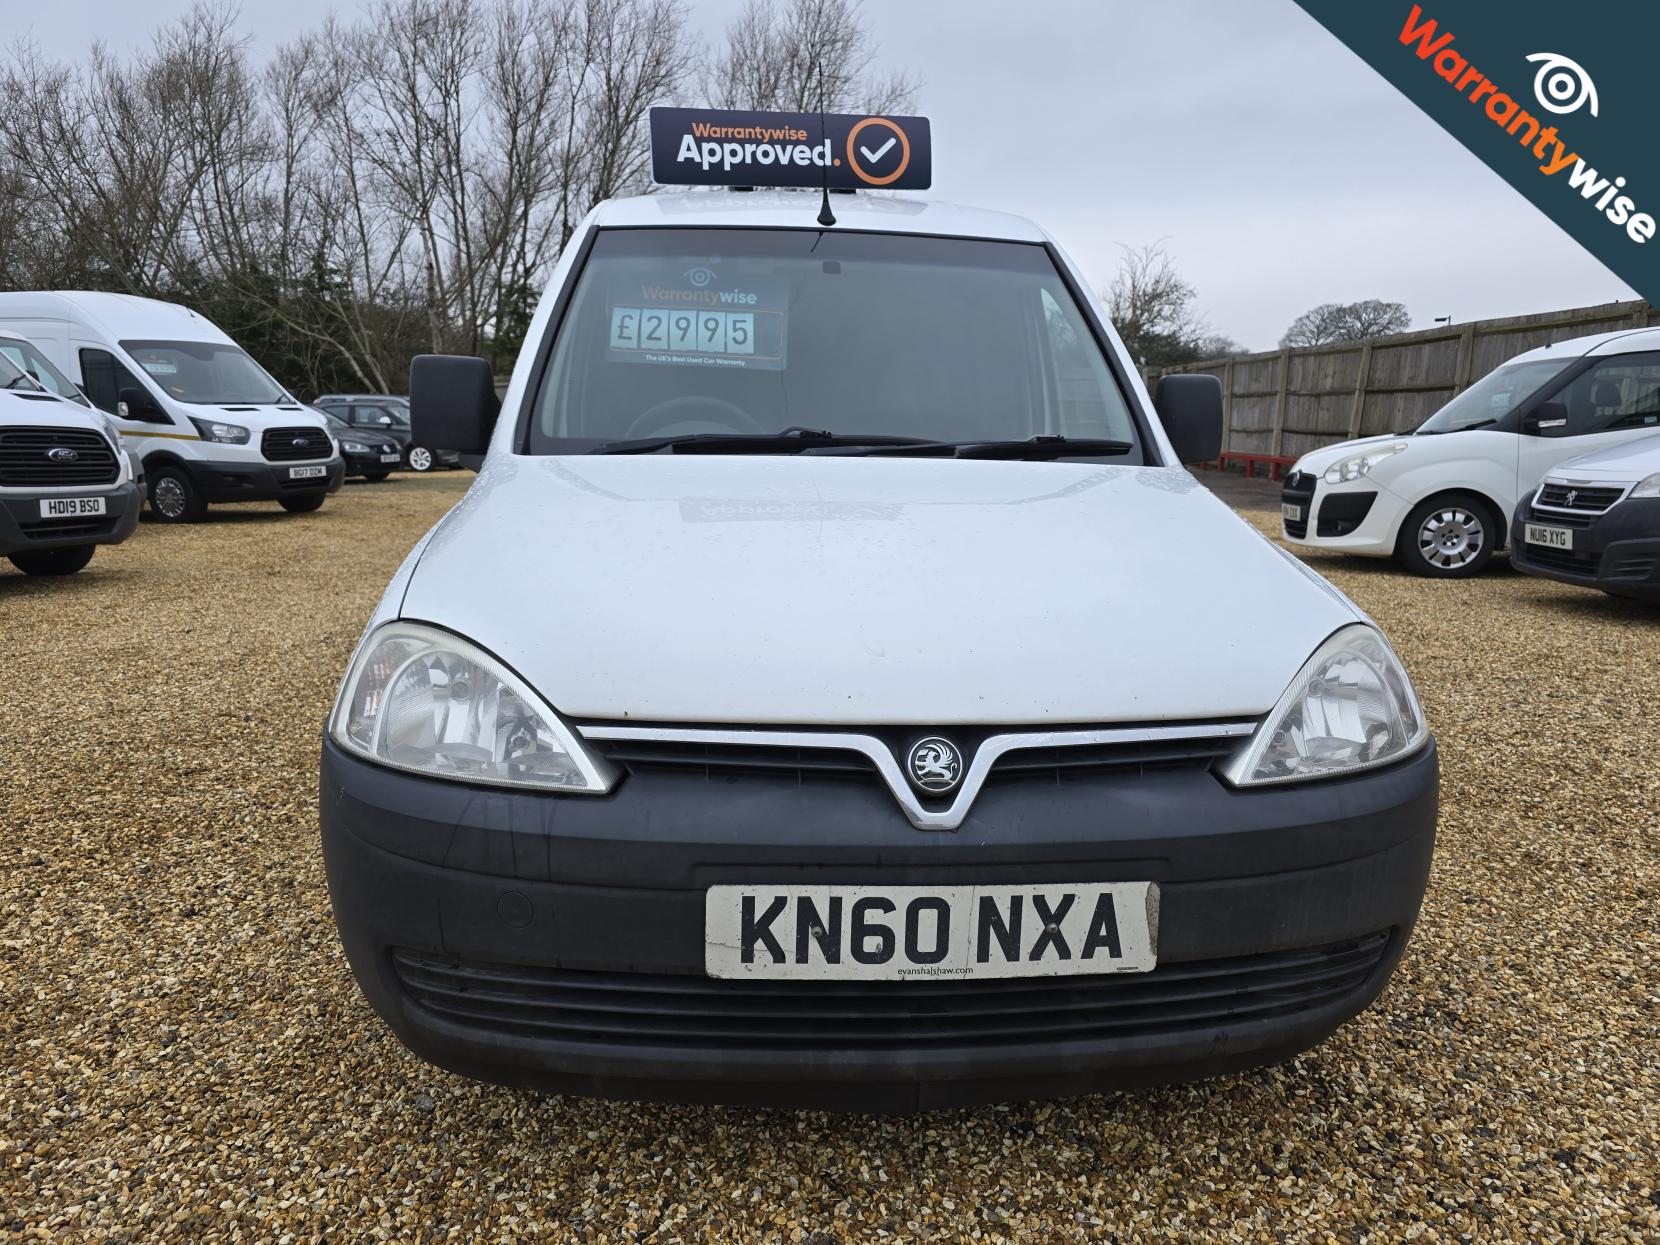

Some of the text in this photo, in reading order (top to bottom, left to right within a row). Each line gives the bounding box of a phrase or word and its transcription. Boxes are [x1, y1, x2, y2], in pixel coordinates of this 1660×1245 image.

[691, 122, 808, 143] Warrantywise
[676, 134, 841, 171] Approved.
[641, 284, 758, 305] Warrantywise
[617, 314, 748, 345] £2995
[49, 500, 76, 514] HD19
[1530, 527, 1566, 546] NU16 XYG
[740, 893, 1123, 964] KN60 NXA
[897, 965, 974, 976] evanshalshaw.com
